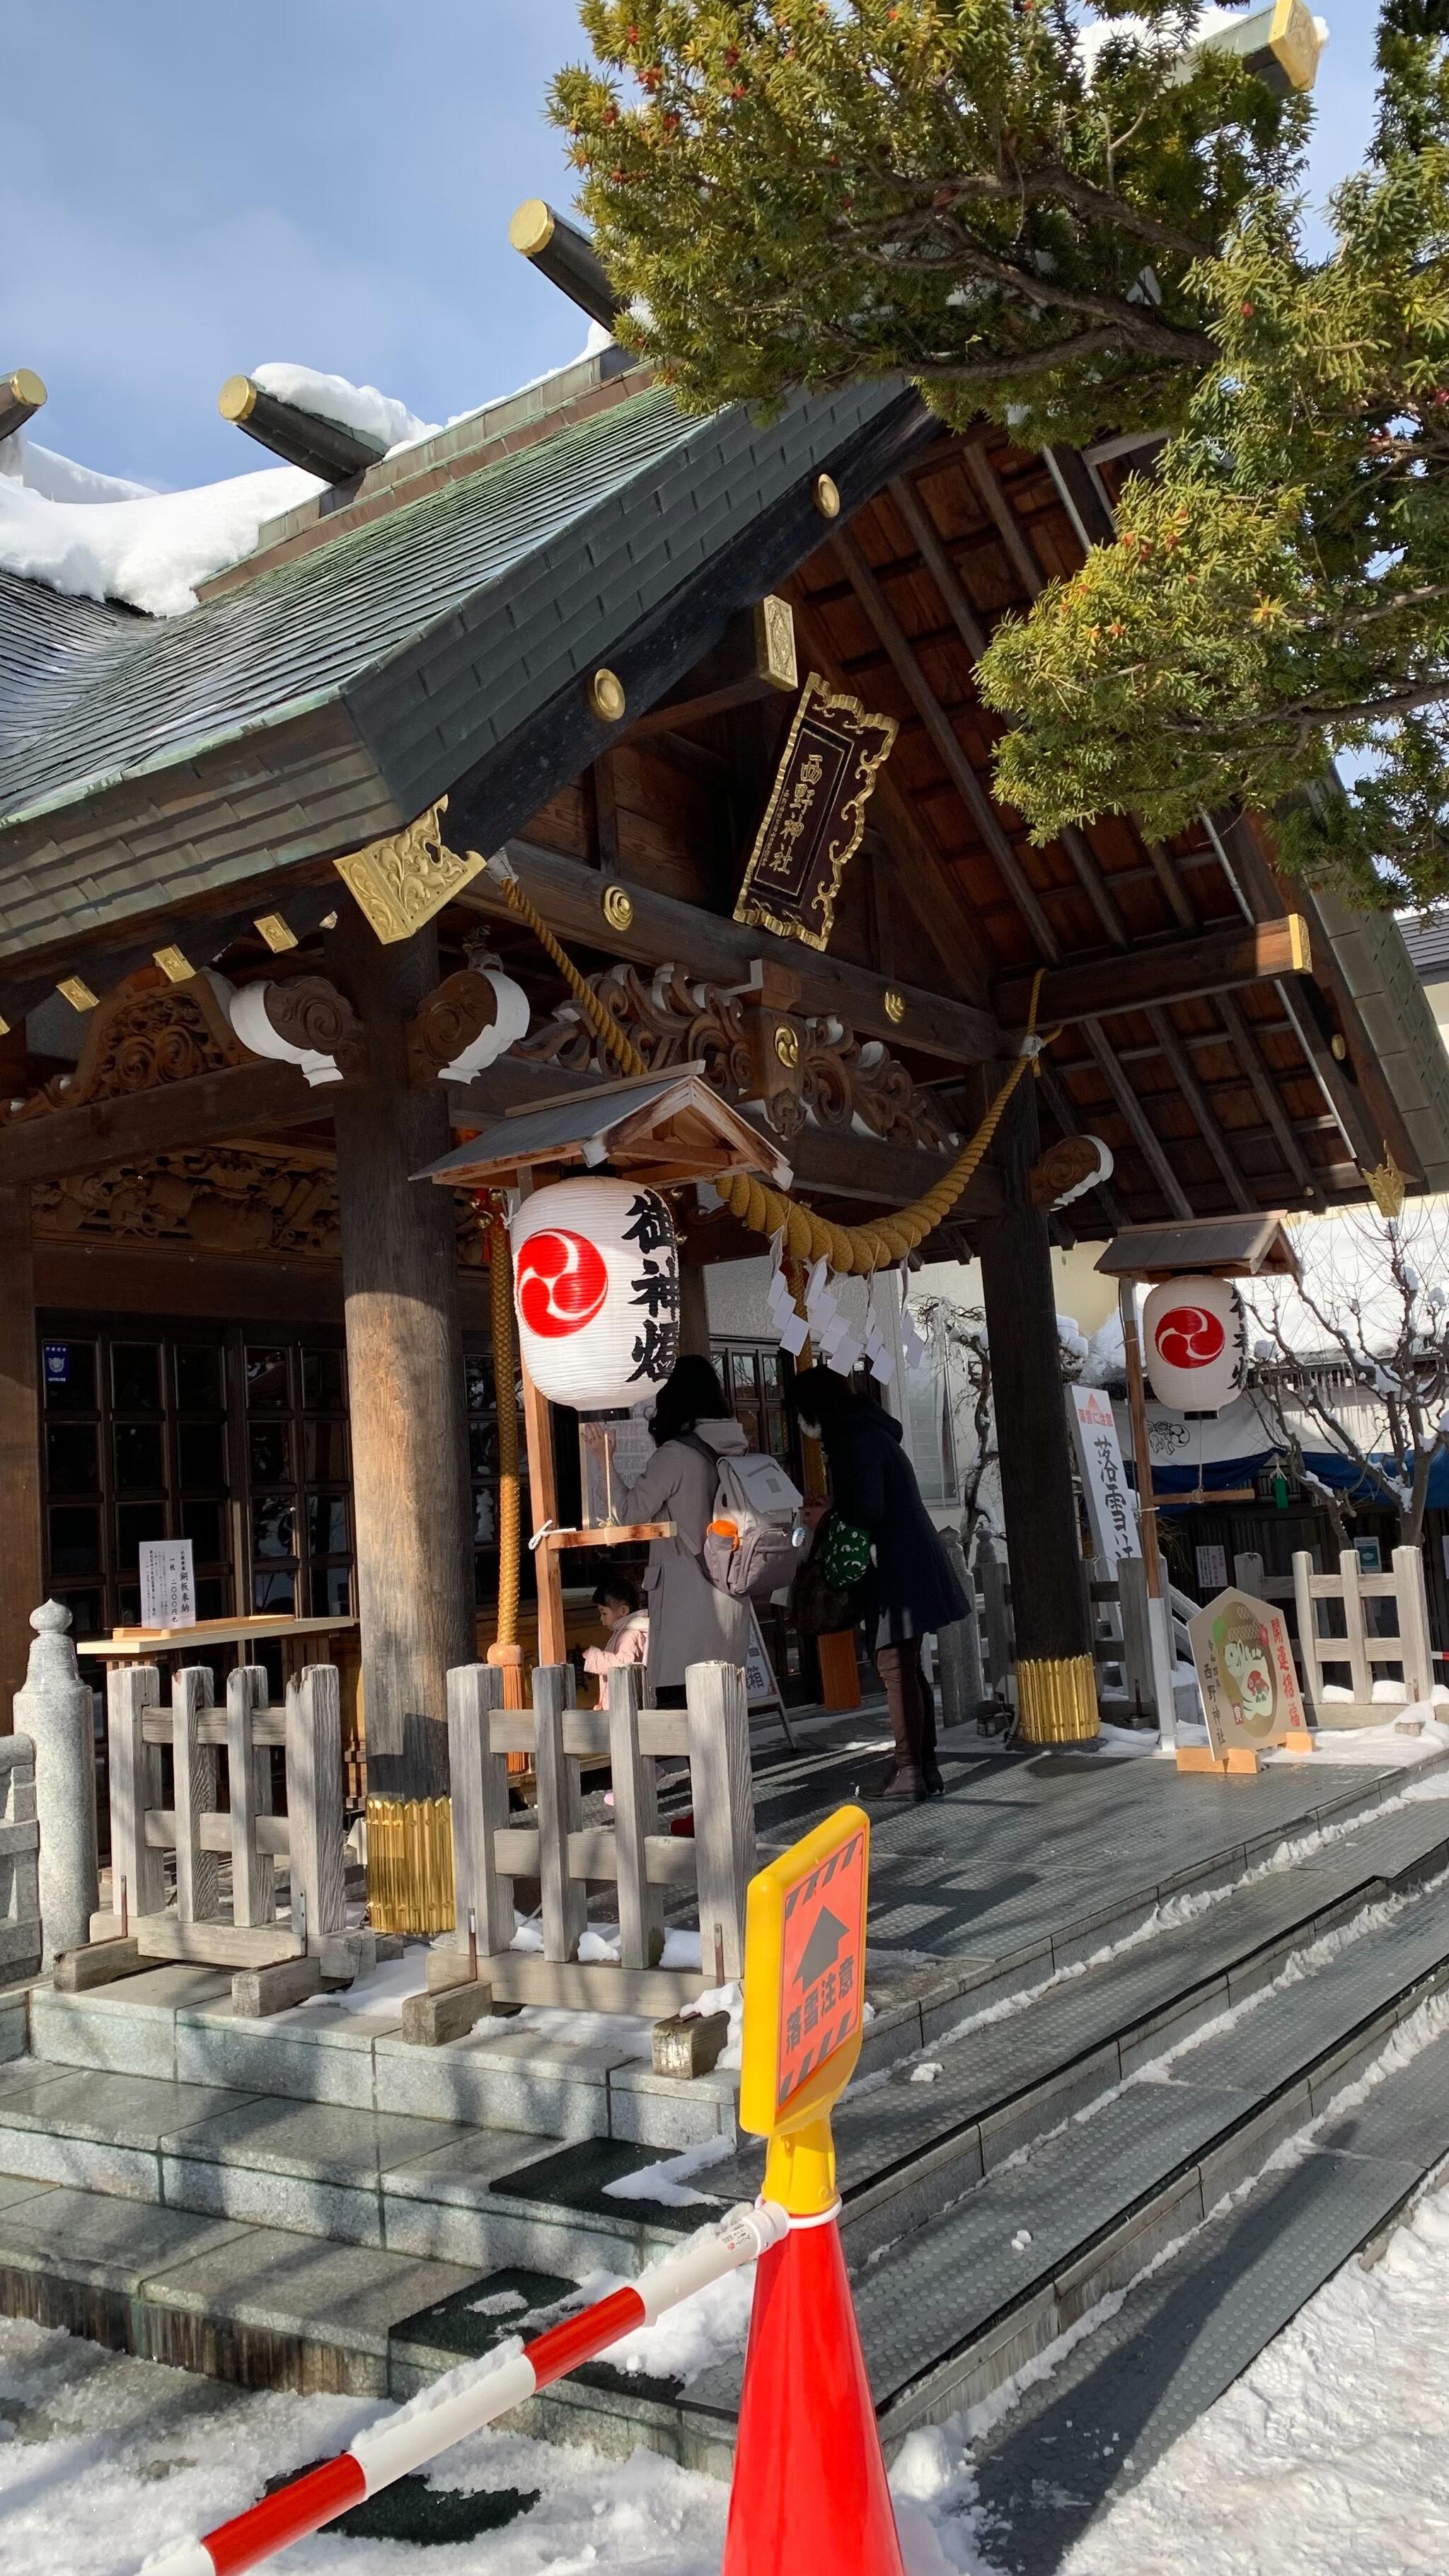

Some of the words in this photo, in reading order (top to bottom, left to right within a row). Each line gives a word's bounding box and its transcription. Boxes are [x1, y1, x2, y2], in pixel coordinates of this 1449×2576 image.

[768, 753, 824, 876] 西野神社
[1078, 1409, 1114, 1427] 落雪に注意
[1203, 1663, 1226, 1746] 西野神社
[785, 1954, 855, 2054] 落雪注意
